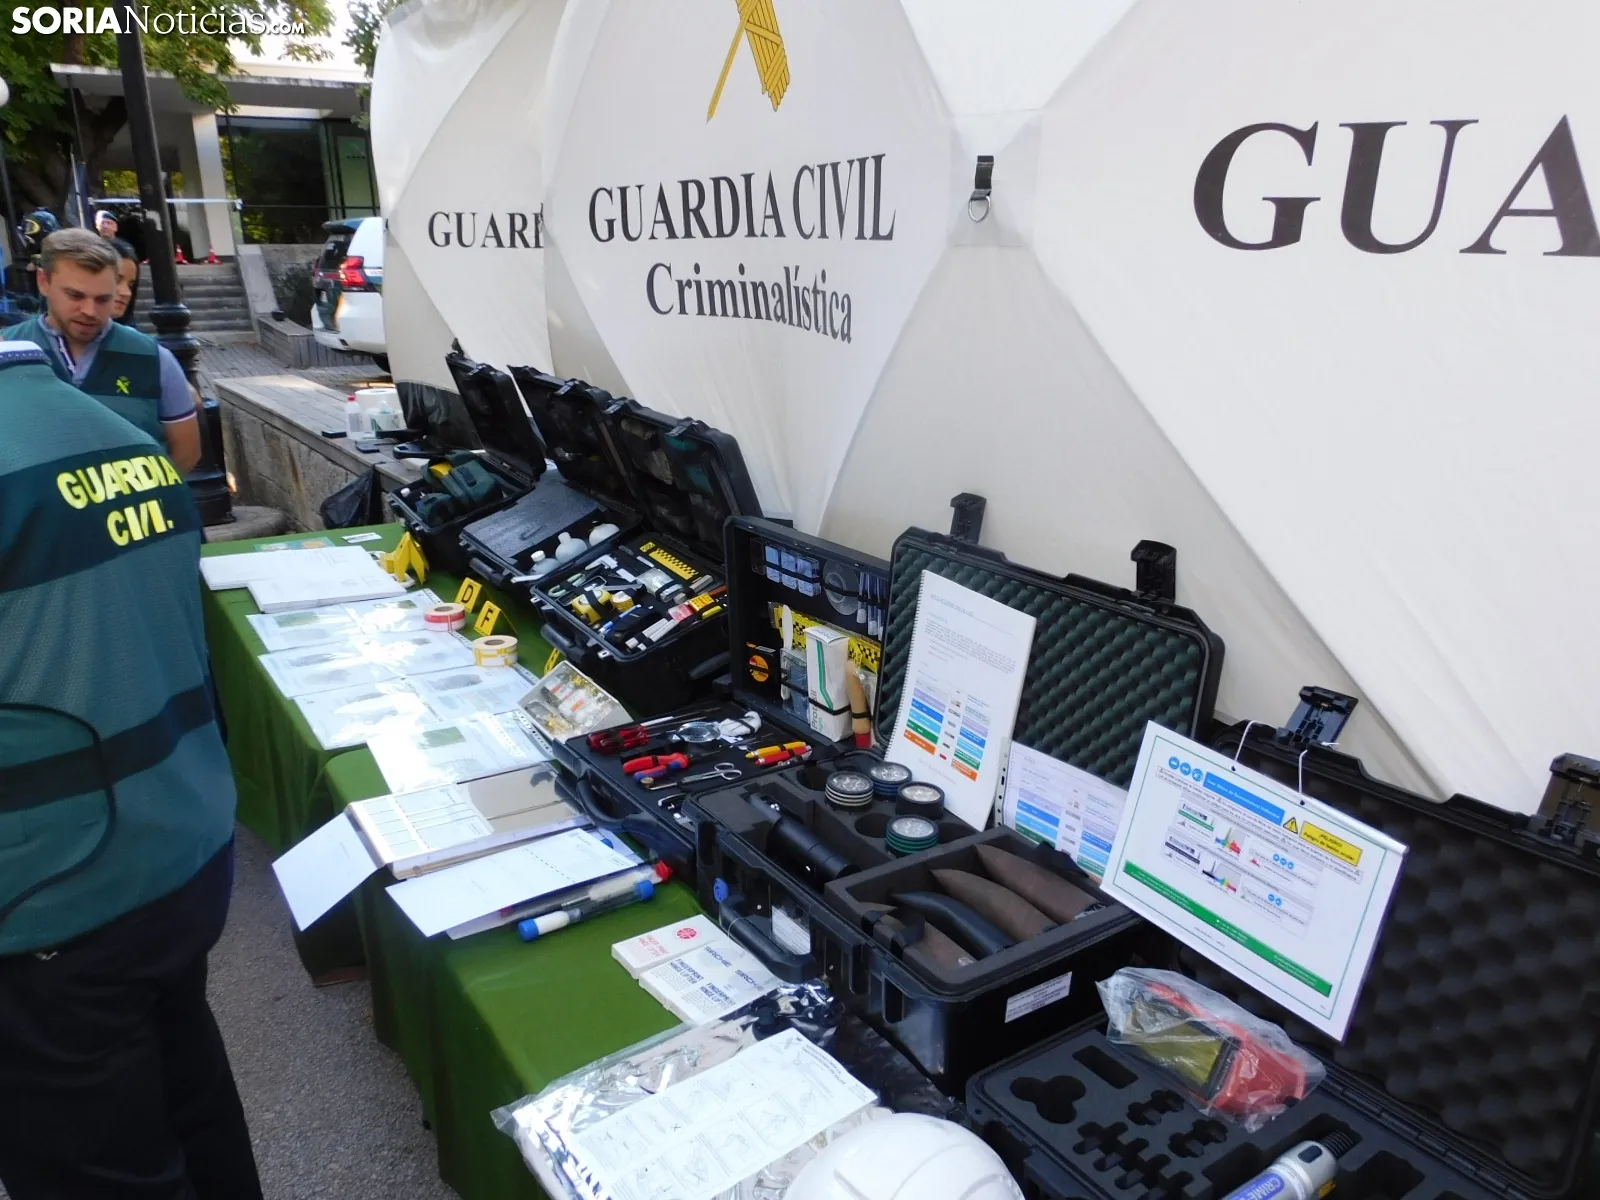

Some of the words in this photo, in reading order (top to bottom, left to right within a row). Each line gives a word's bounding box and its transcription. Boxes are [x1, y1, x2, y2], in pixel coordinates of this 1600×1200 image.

[588, 169, 787, 243] GUARDIA
[792, 153, 897, 242] CIVIL
[646, 261, 853, 345] Criminalística
[56, 455, 184, 510] GUARDIA
[461, 583, 475, 604] D
[480, 608, 494, 628] F
